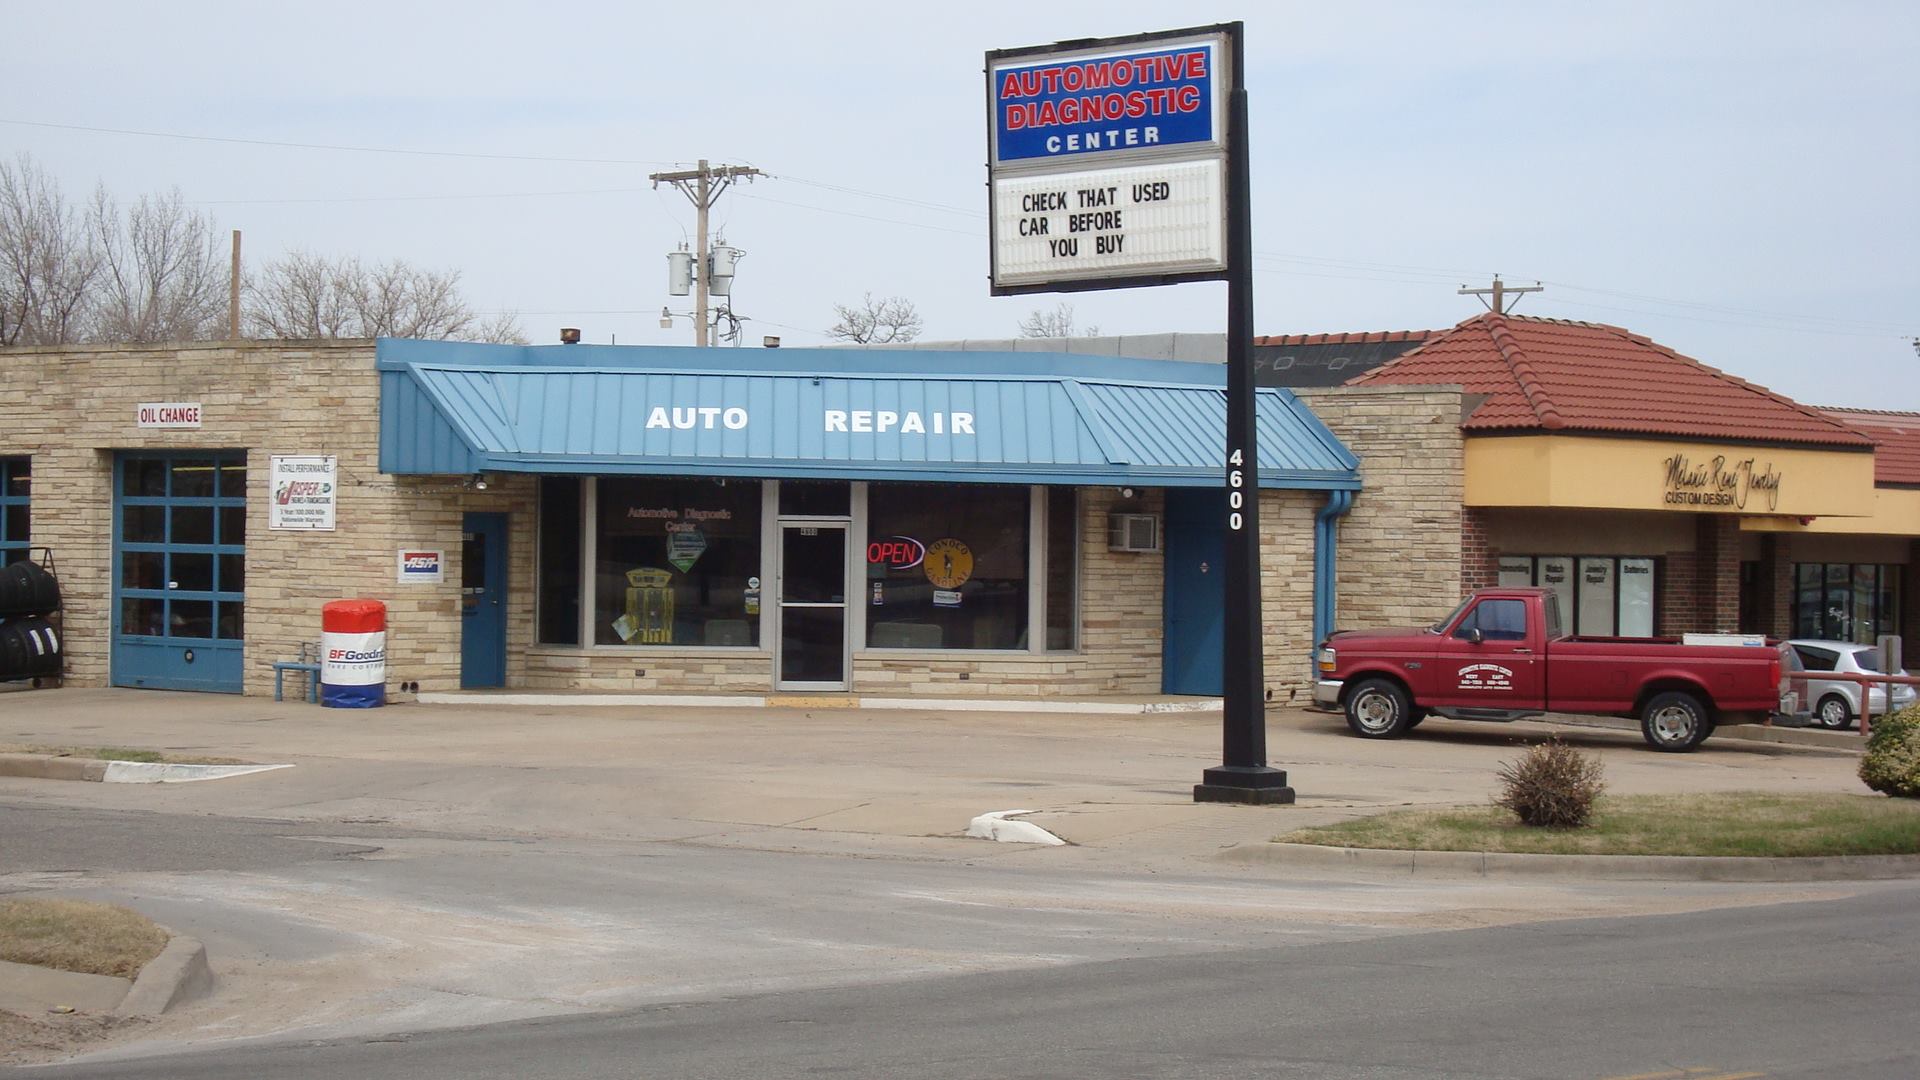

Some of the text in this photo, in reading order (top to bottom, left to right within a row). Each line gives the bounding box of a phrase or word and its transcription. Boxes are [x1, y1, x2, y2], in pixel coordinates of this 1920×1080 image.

[1001, 52, 1207, 100] AUTOMOTIVE
[1006, 85, 1201, 131] DIAGNOSTIC
[1046, 126, 1159, 153] CENTER
[1022, 181, 1170, 213] CHECK THAT USED
[1019, 210, 1122, 237] CAR BEFORE
[1049, 234, 1125, 258] YOU BUY
[140, 407, 199, 423] OIL CHANGE
[646, 406, 976, 435] AUTO REPAIR
[278, 464, 331, 473] INSTALL PERFORMANCE
[278, 480, 320, 505] JASPER
[1229, 448, 1243, 530] 4600
[1665, 491, 1735, 506] CUSTOM DESIGN
[627, 506, 732, 521] Automotive Diagnostic
[664, 520, 697, 533] Center
[867, 543, 917, 563] OPEN
[928, 540, 969, 556] CONOCO
[926, 567, 970, 587] GASOLINE
[1545, 564, 1565, 574] Watch
[1585, 564, 1608, 575] Jewelry
[1623, 564, 1649, 574] Batteries
[1545, 575, 1565, 585] Repair
[1585, 575, 1606, 585] Repair
